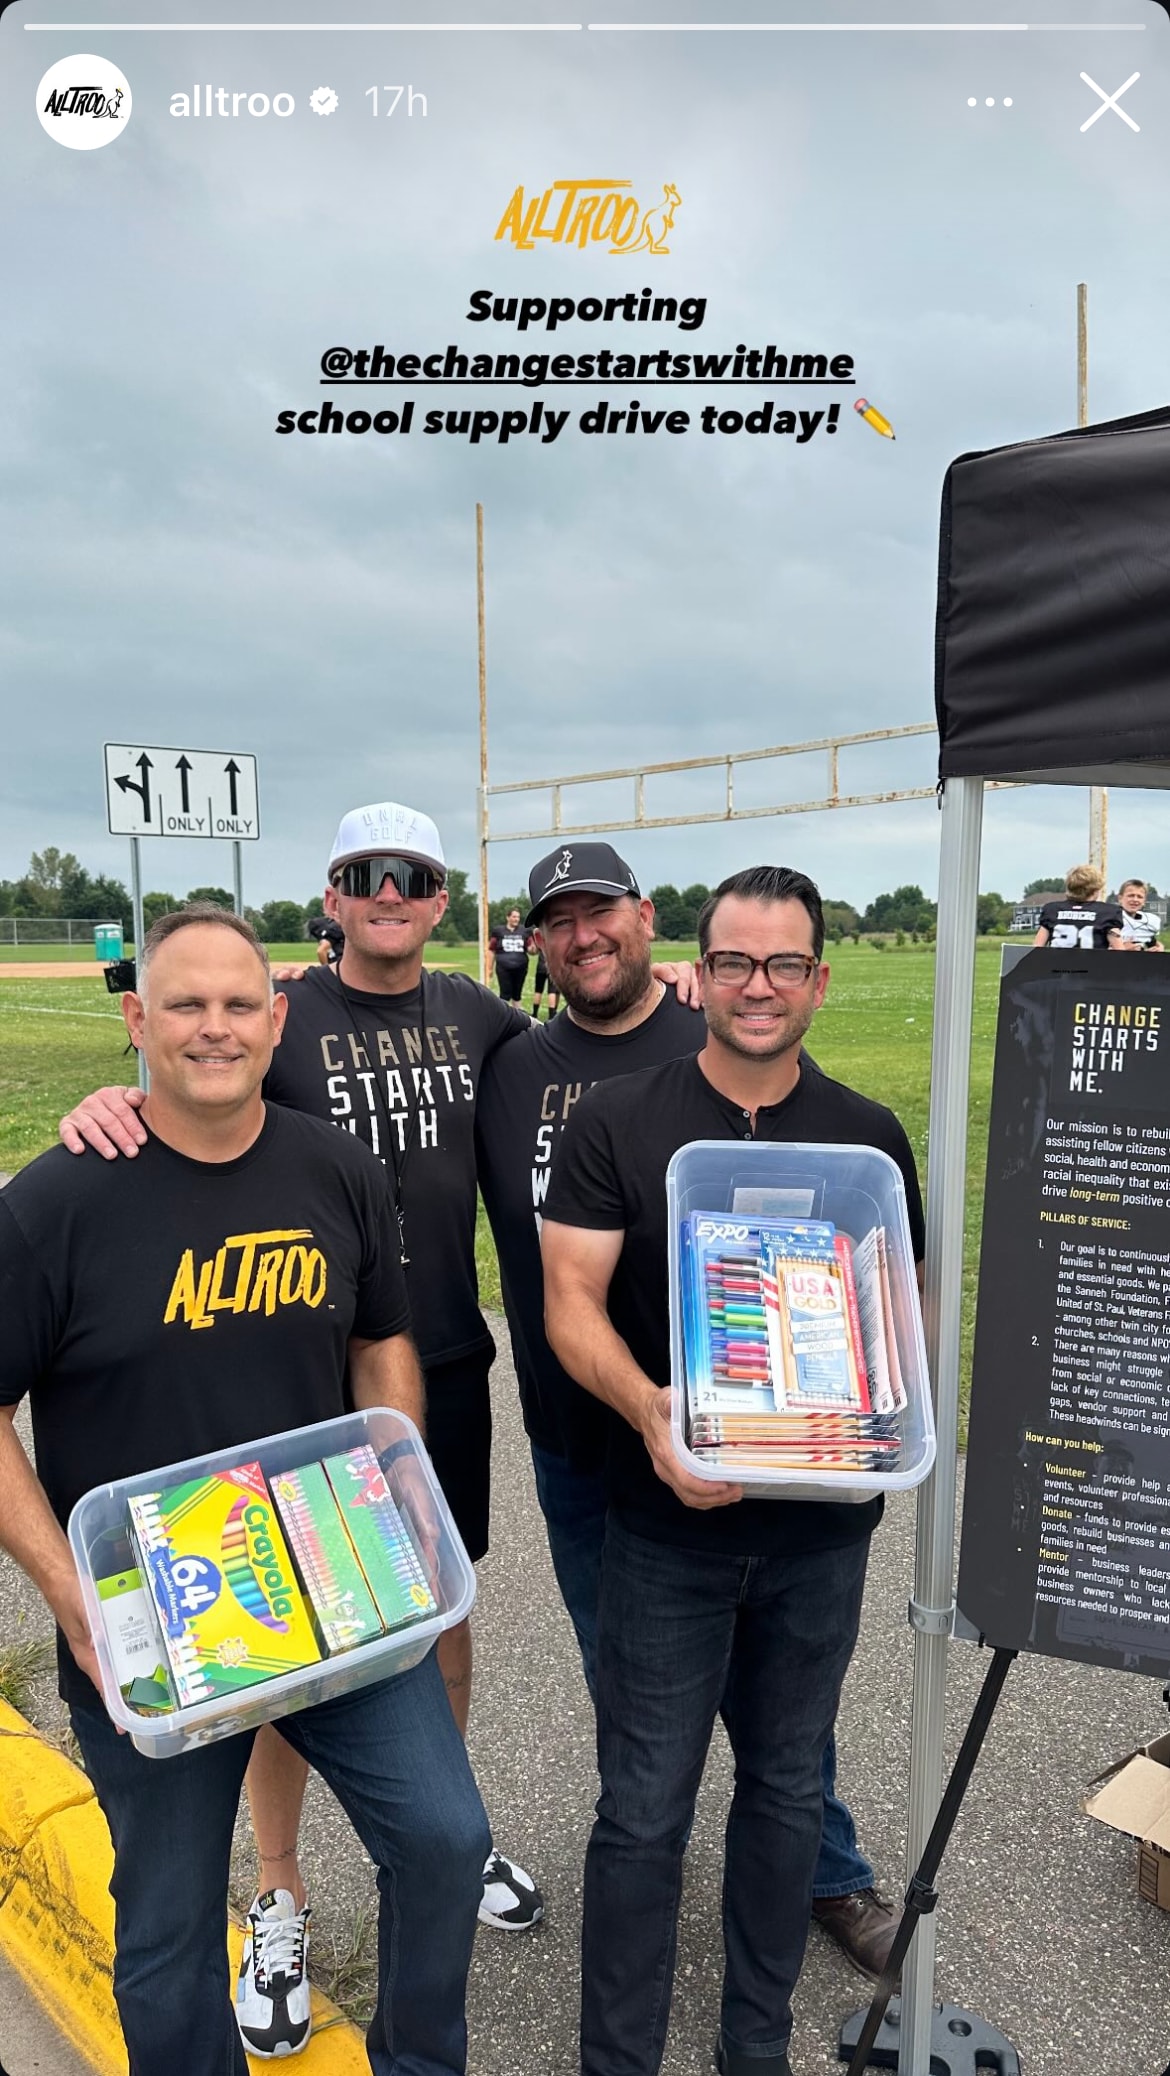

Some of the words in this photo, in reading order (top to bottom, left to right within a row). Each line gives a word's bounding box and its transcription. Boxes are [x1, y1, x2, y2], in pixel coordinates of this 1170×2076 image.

[167, 816, 205, 831] ONLY
[216, 819, 252, 833] ONLY
[1074, 1002, 1162, 1029] CHANGE
[319, 1025, 467, 1072] CHANGE
[1072, 1025, 1159, 1052] STARTS
[1072, 1047, 1124, 1072] WITH
[326, 1064, 474, 1116] STARTS
[1069, 1070, 1103, 1094] ME.
[1046, 1118, 1065, 1131] Our
[1068, 1120, 1108, 1135] mission
[1112, 1123, 1122, 1136] is
[1126, 1125, 1138, 1137] to
[1045, 1135, 1091, 1152] assisting
[1092, 1138, 1124, 1153] fellow
[1125, 1141, 1167, 1157] citizens
[1043, 1152, 1075, 1166] social,
[1076, 1153, 1108, 1168] health
[1108, 1158, 1129, 1170] and
[1043, 1168, 1072, 1181] racial
[1075, 1170, 1126, 1189] inequality
[1128, 1175, 1150, 1189] that
[1041, 1183, 1068, 1198] drive
[1069, 1186, 1120, 1203] long-term
[1122, 1193, 1164, 1207] positive
[1039, 1210, 1076, 1224] PILLARS
[1077, 1215, 1090, 1226] OF
[1090, 1216, 1131, 1230] SERVICE:
[696, 1221, 749, 1244] EXPO
[1038, 1238, 1044, 1249] 1.
[1060, 1240, 1076, 1252] Our
[1077, 1244, 1096, 1255] goal
[1097, 1244, 1106, 1256] is
[1107, 1247, 1117, 1257] to
[1059, 1255, 1094, 1268] families
[1097, 1258, 1107, 1270] in
[1110, 1262, 1133, 1273] need
[1136, 1264, 1156, 1276] with
[163, 1229, 327, 1330] ALLTROO
[791, 1275, 834, 1297] USA
[1058, 1270, 1075, 1280] and
[1076, 1272, 1115, 1285] essential
[1115, 1277, 1145, 1289] goods.
[1147, 1278, 1161, 1291] We
[794, 1296, 837, 1310] GOLD
[1057, 1283, 1072, 1294] the
[1074, 1284, 1108, 1299] Sanneh
[1110, 1289, 1162, 1306] Foundation,
[1056, 1296, 1083, 1310] United
[1083, 1300, 1094, 1311] of
[1127, 1305, 1164, 1320] Veterans
[1054, 1325, 1096, 1340] churches,
[1097, 1331, 1131, 1344] schools
[1132, 1335, 1150, 1347] and
[1062, 1313, 1092, 1327] among
[1094, 1316, 1119, 1328] other
[1120, 1319, 1140, 1332] twin
[1142, 1321, 1160, 1336] city
[807, 1341, 834, 1351] WOOD
[1031, 1335, 1040, 1346] 2.
[1053, 1338, 1079, 1352] There
[1080, 1343, 1095, 1354] are
[1096, 1346, 1121, 1359] many
[1122, 1350, 1158, 1362] reasons
[1052, 1352, 1090, 1367] business
[1095, 1359, 1121, 1372] might
[1127, 1364, 1164, 1379] struggle
[1051, 1366, 1073, 1379] from
[1076, 1371, 1102, 1383] social
[1105, 1376, 1116, 1385] or
[1119, 1378, 1163, 1392] economic
[703, 1391, 718, 1402] 21
[1050, 1380, 1069, 1393] lack
[1071, 1383, 1082, 1395] of
[1083, 1385, 1100, 1399] key
[1102, 1390, 1158, 1407] connections,
[1048, 1408, 1075, 1422] These
[1075, 1412, 1122, 1429] headwinds
[1122, 1421, 1139, 1432] can
[1140, 1421, 1152, 1434] be
[1049, 1396, 1073, 1409] gaps,
[1077, 1400, 1108, 1413] vendor
[1111, 1405, 1147, 1419] support
[1151, 1410, 1169, 1423] and
[1025, 1430, 1044, 1444] How
[1045, 1436, 1062, 1446] can
[1063, 1439, 1080, 1450] you
[1081, 1439, 1104, 1454] help:
[1044, 1479, 1075, 1492] events,
[1078, 1483, 1119, 1498] volunteer
[1045, 1462, 1086, 1478] Volunteer
[1102, 1474, 1136, 1487] provide
[1141, 1477, 1161, 1492] help
[1043, 1492, 1060, 1504] and
[1060, 1495, 1104, 1510] resources
[1042, 1504, 1073, 1520] Donate
[1083, 1511, 1110, 1527] funds
[1111, 1517, 1122, 1529] to
[1124, 1520, 1158, 1534] provide
[1040, 1521, 1069, 1534] goods,
[1072, 1525, 1103, 1539] rebuild
[1106, 1529, 1155, 1548] businesses
[1040, 1533, 1074, 1549] families
[1075, 1539, 1084, 1551] in
[1086, 1543, 1108, 1555] need
[244, 1504, 293, 1618] Crayola
[1039, 1547, 1070, 1562] Mentor
[1091, 1556, 1130, 1573] business
[170, 1559, 217, 1611] 64
[1037, 1563, 1070, 1577] provide
[1075, 1570, 1124, 1588] mentorship
[1130, 1578, 1140, 1590] to
[1145, 1580, 1168, 1596] local
[156, 1559, 174, 1594] Washable
[168, 1593, 180, 1625] Markers
[1036, 1575, 1075, 1592] business
[1083, 1586, 1115, 1600] owners
[1123, 1592, 1142, 1605] who
[1151, 1596, 1170, 1610] lack
[1035, 1592, 1076, 1607] resources
[1077, 1599, 1108, 1613] needed
[1109, 1604, 1118, 1615] to
[1119, 1607, 1153, 1622] prosper
[1153, 1613, 1170, 1624] and
